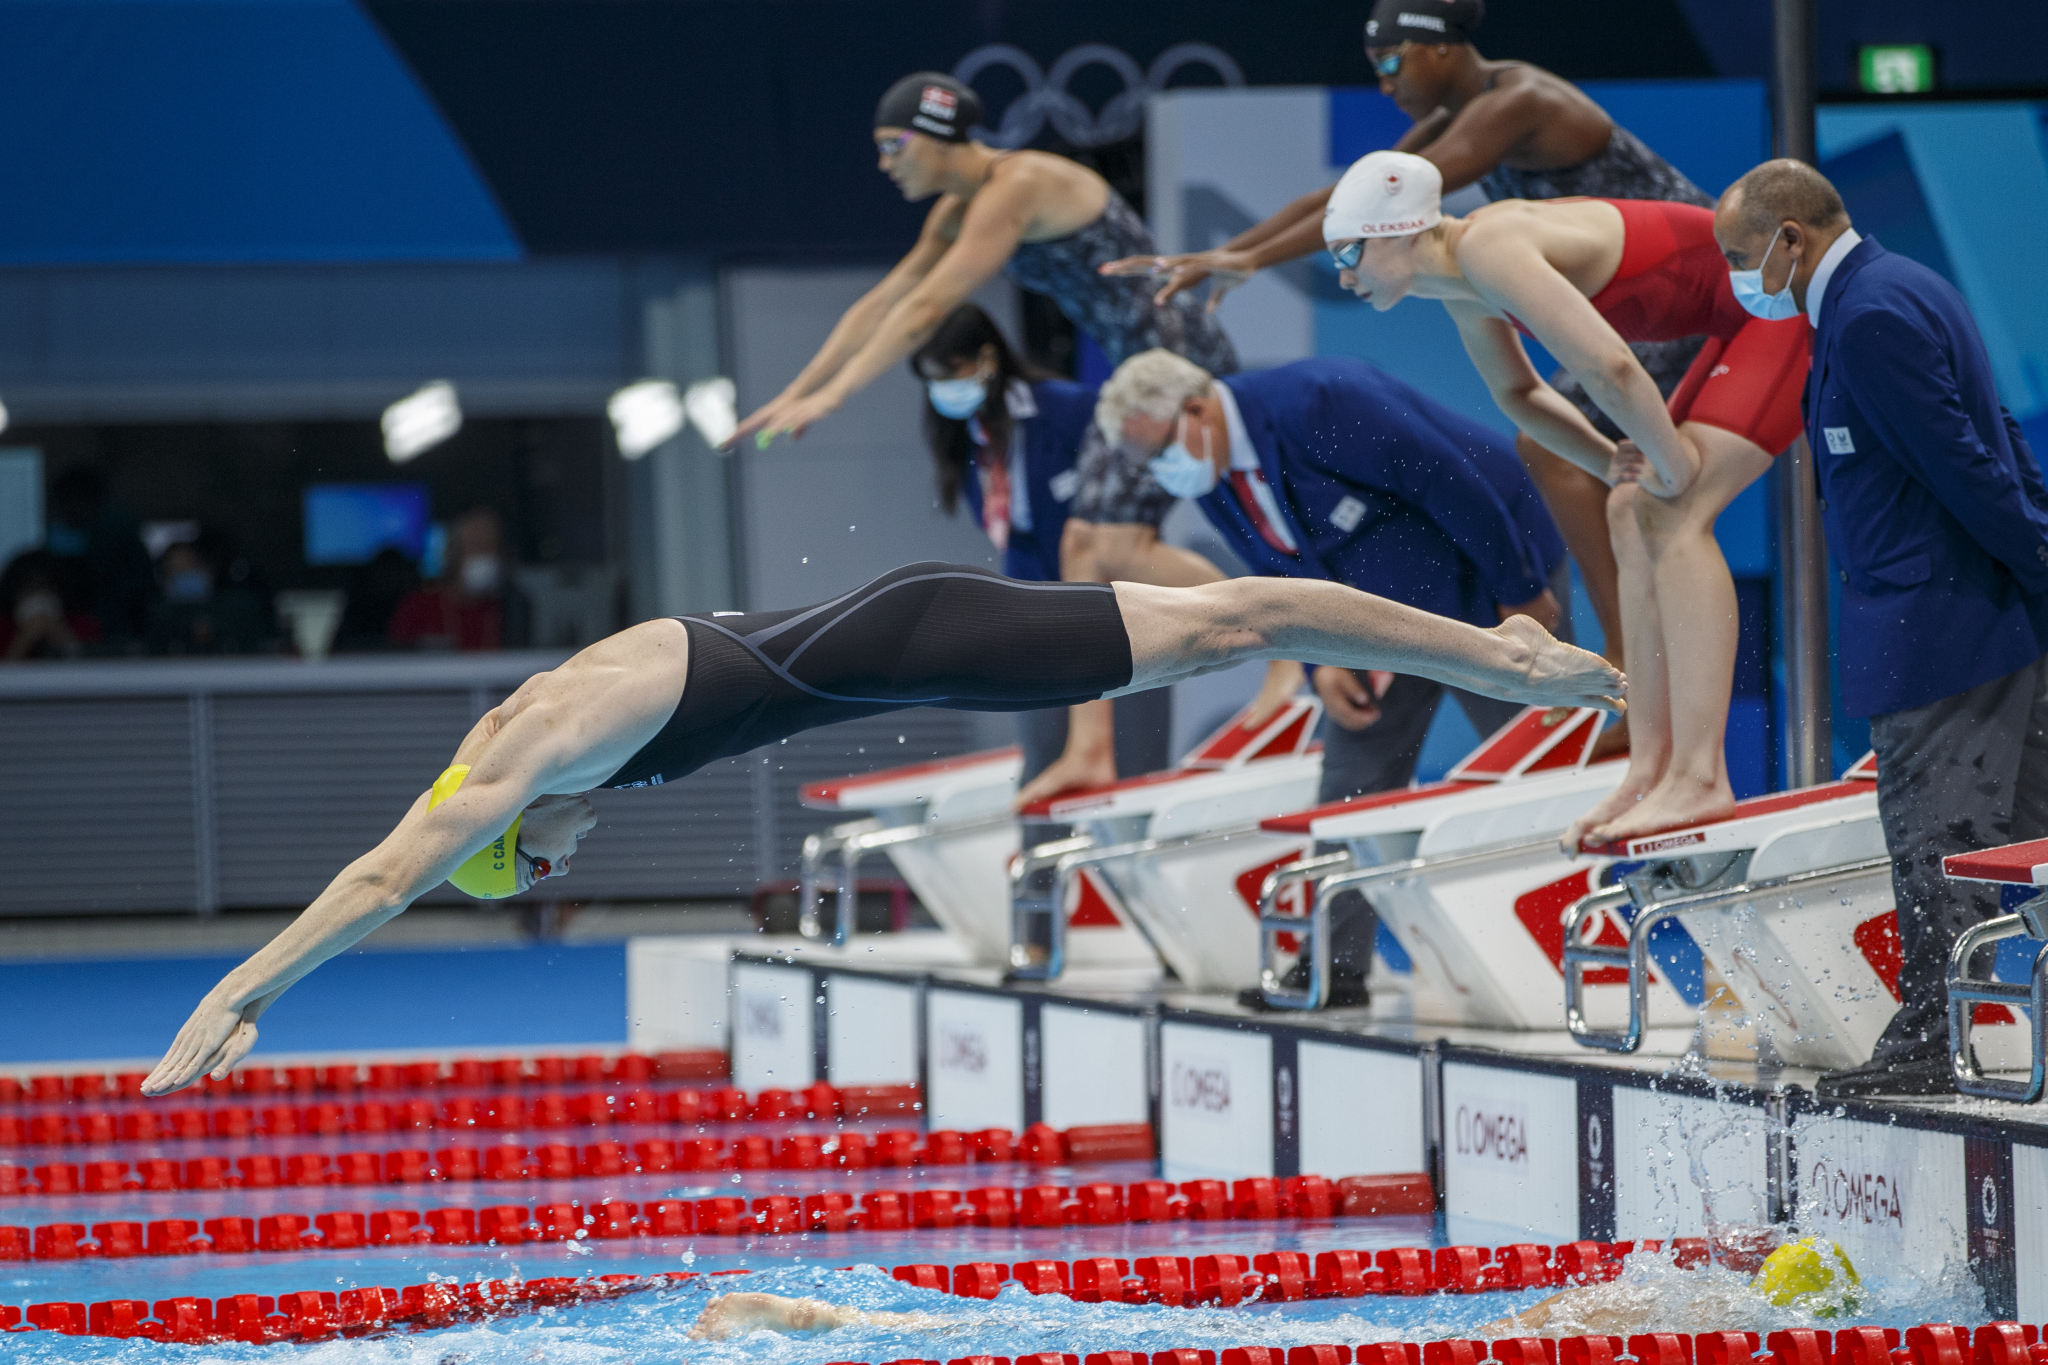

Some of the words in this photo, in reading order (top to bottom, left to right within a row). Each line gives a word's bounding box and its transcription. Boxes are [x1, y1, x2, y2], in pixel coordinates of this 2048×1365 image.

[1361, 218, 1426, 234] OLEKSIAK
[1654, 834, 1699, 850] OMEGA
[493, 862, 505, 870] C
[1472, 1111, 1529, 1164] OMEGA
[1832, 1168, 1903, 1228] OMEGA
